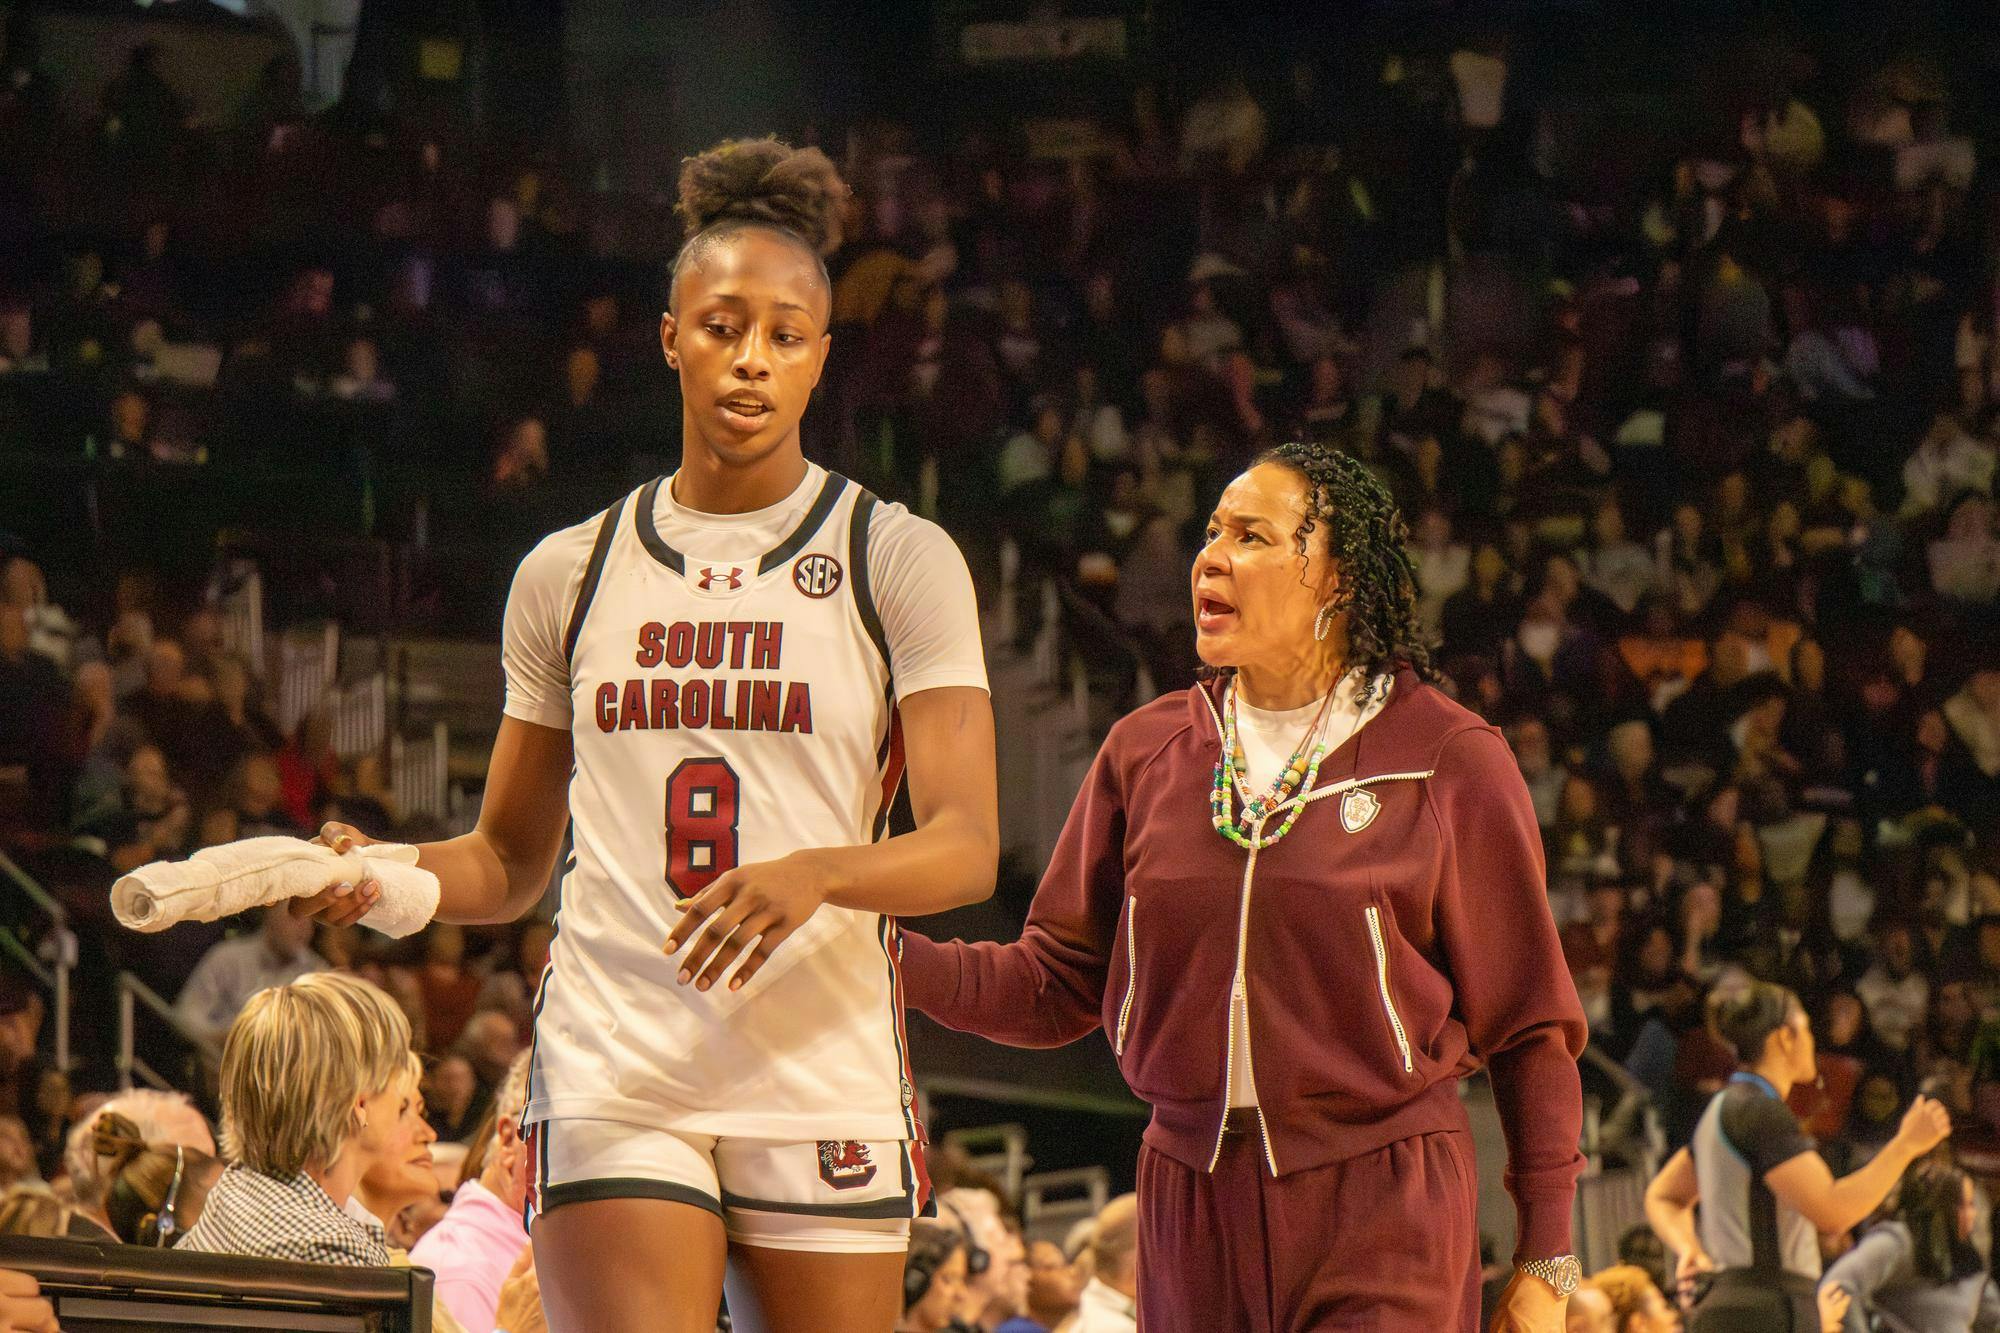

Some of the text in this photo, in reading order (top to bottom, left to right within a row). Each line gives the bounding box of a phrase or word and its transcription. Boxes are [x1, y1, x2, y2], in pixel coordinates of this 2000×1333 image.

[798, 557, 838, 594] SEC
[636, 621, 783, 669] SOUTH
[596, 679, 813, 734] CAROLINA
[664, 756, 740, 899] 8
